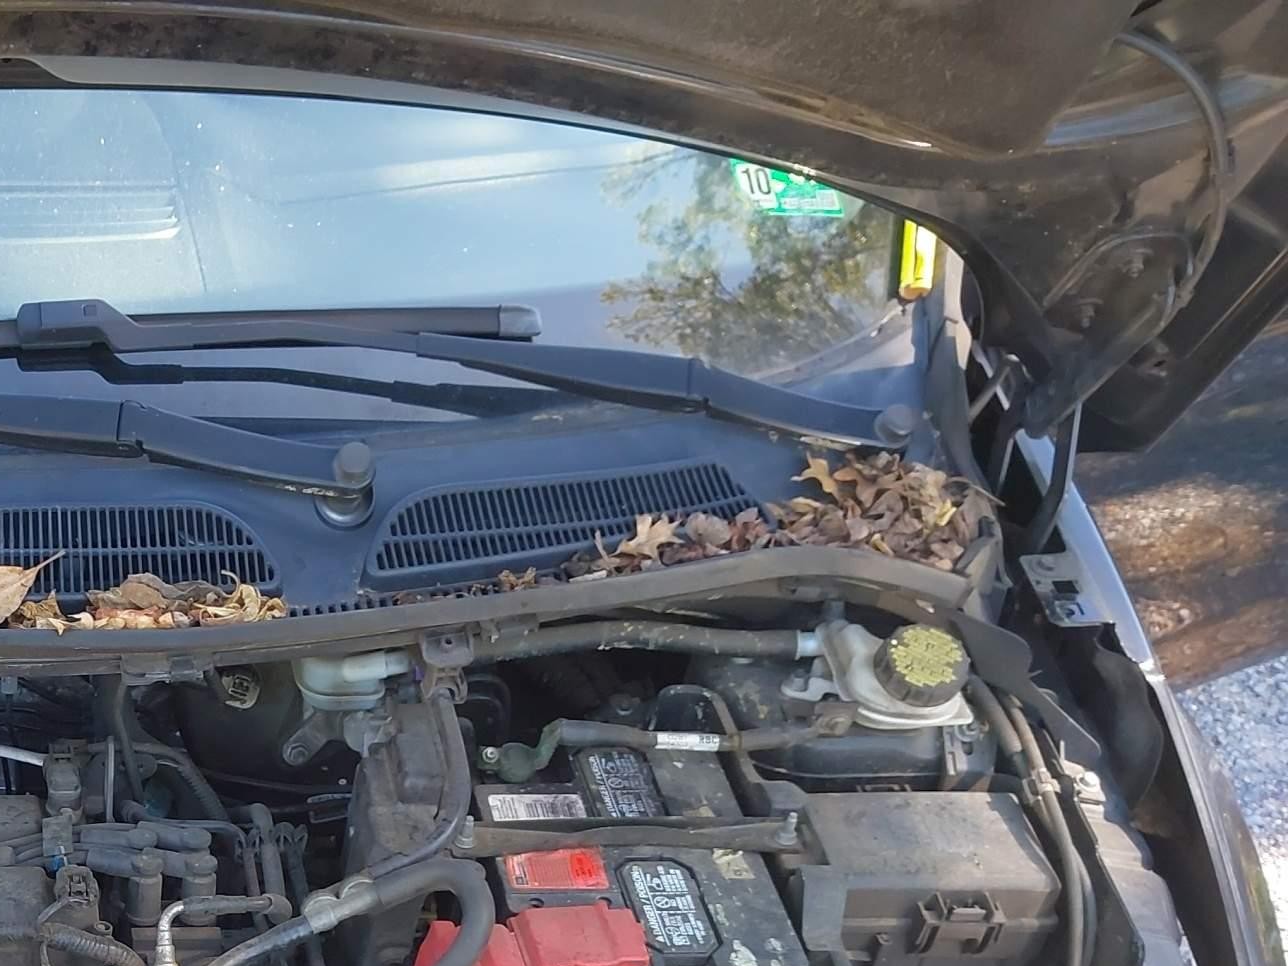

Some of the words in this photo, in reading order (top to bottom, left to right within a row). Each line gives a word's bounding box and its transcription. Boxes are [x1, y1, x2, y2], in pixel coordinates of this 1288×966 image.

[741, 167, 771, 195] 10
[630, 871, 649, 898] POISON
[642, 904, 662, 935] DANGER
